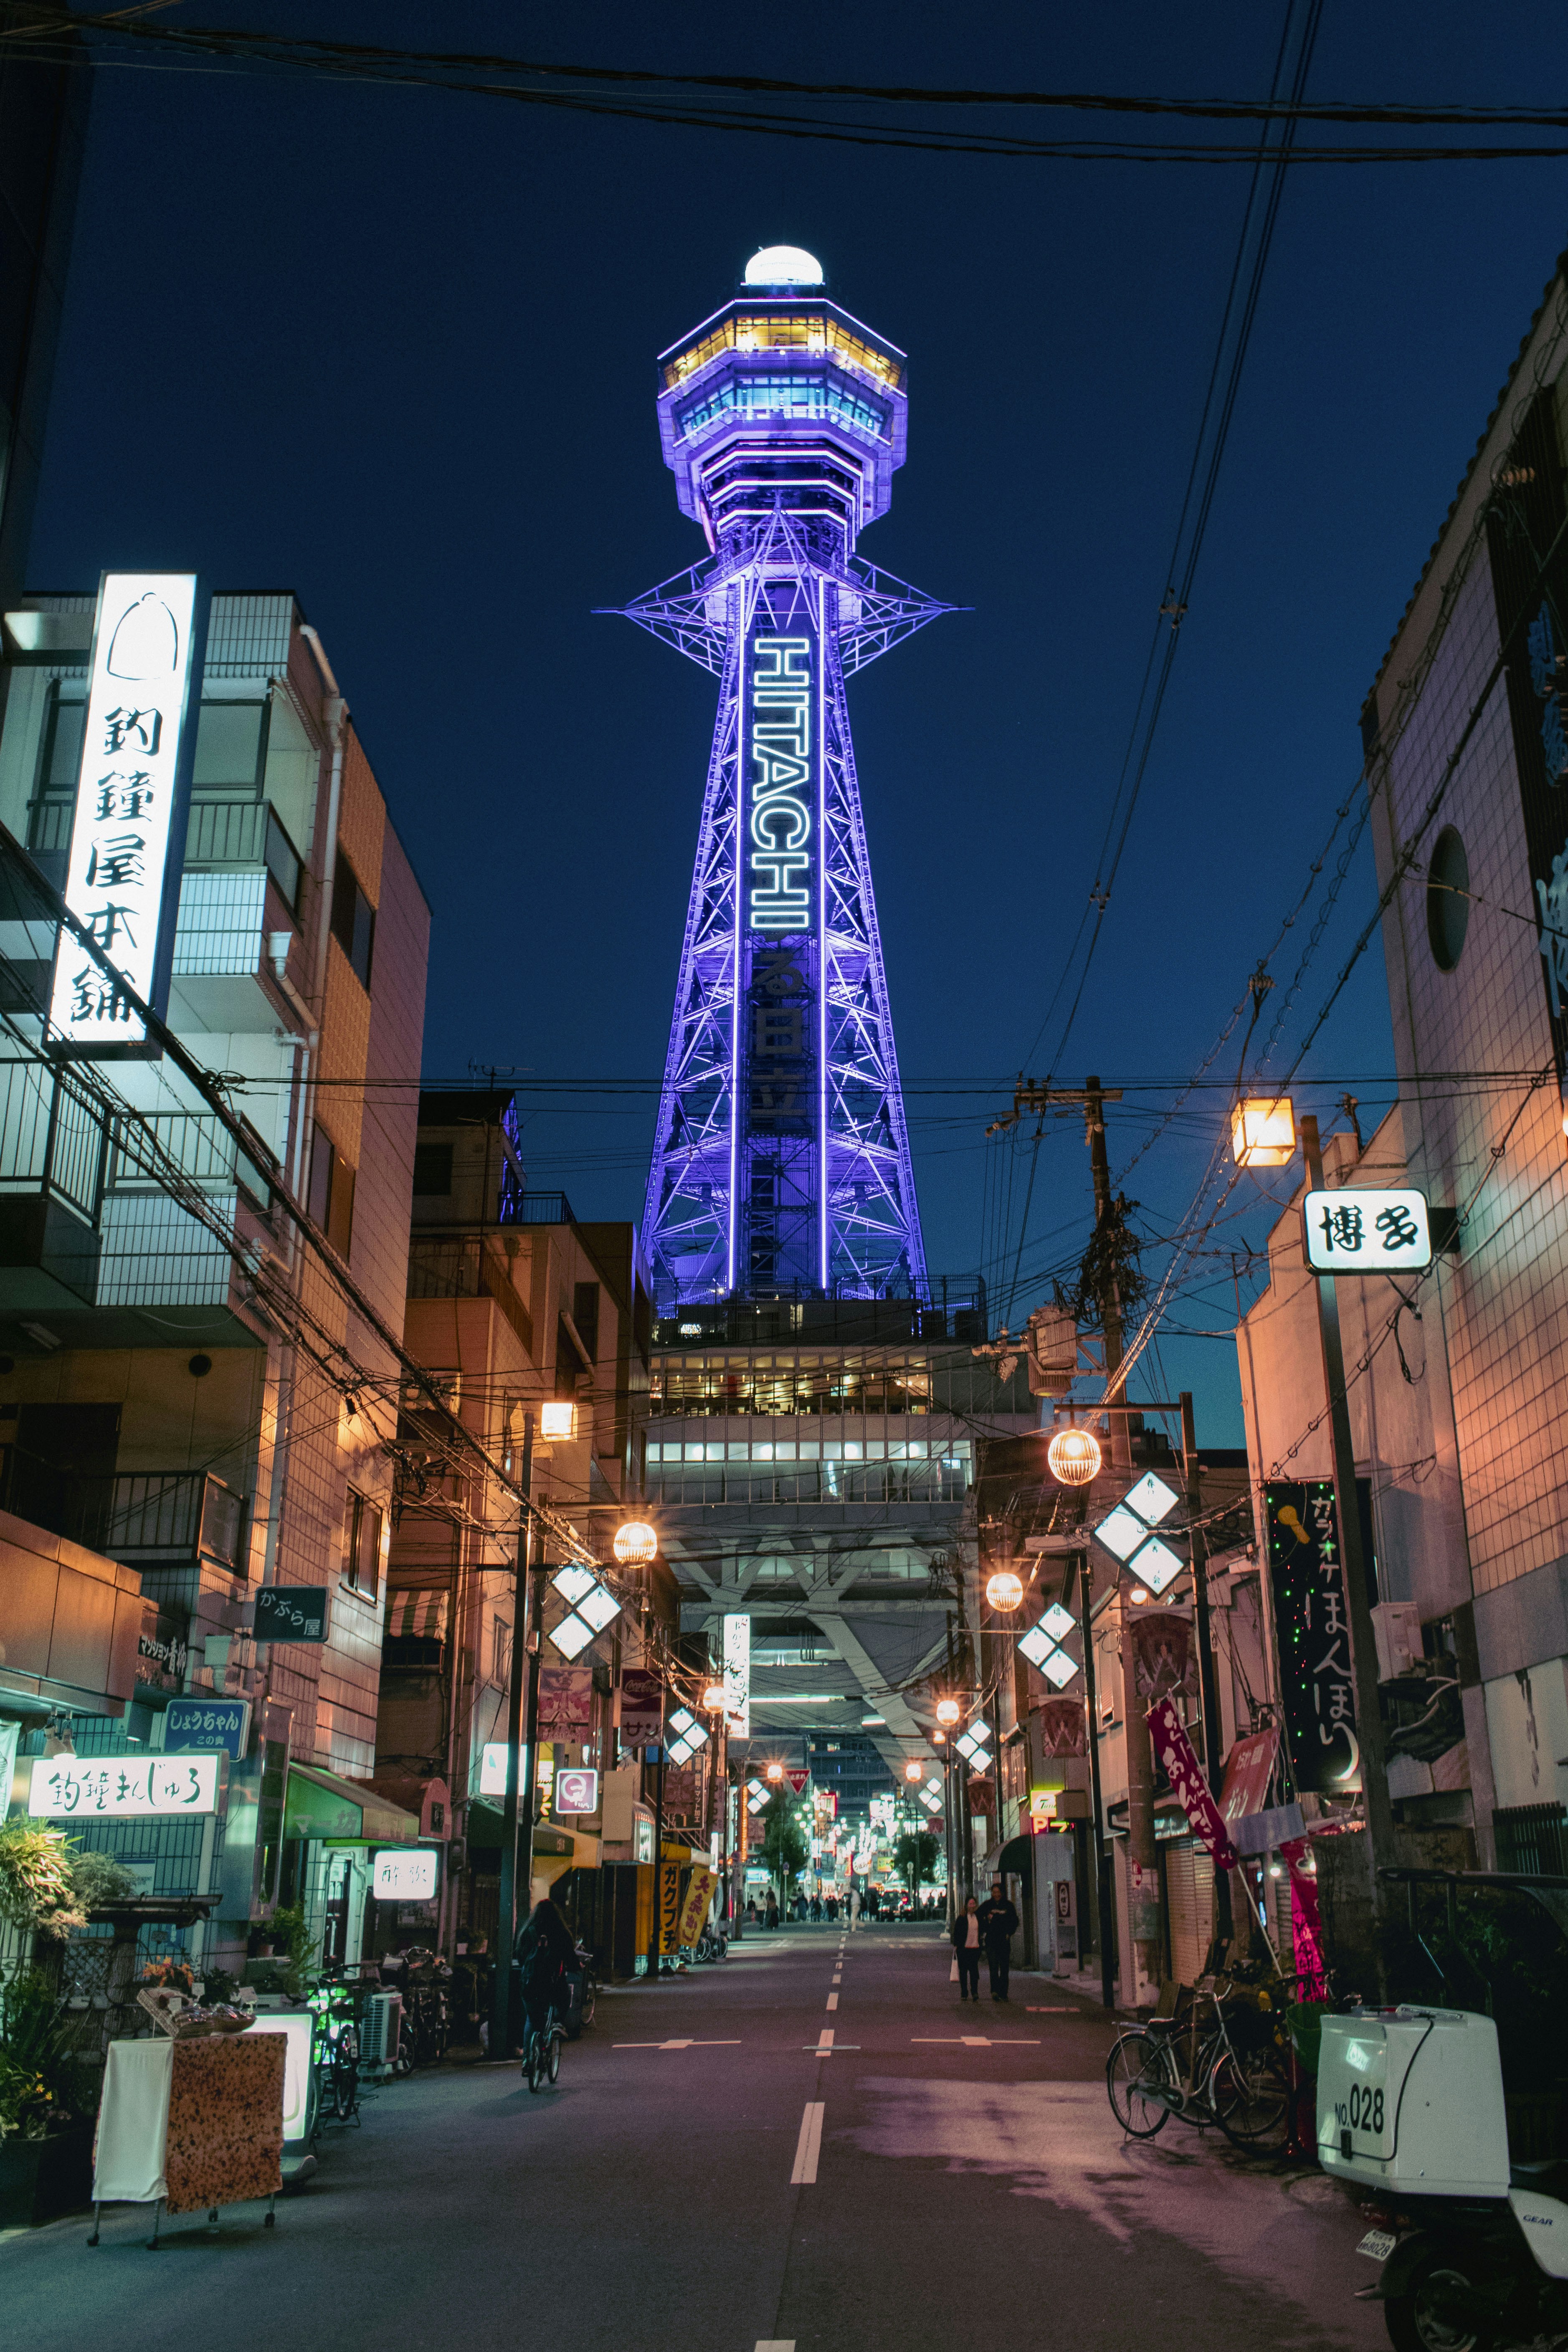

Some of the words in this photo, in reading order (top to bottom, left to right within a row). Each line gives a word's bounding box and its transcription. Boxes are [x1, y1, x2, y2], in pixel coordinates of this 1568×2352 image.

[752, 637, 810, 929] HITACHI
[70, 706, 164, 1023] 釣鐘屋本舗
[750, 930, 806, 1115] る日立
[1319, 1204, 1419, 1252] 博多
[1311, 1497, 1340, 1584] カラオケ
[259, 1591, 321, 1636] かぶら屋
[141, 1635, 187, 1677] マンション青柳
[170, 1710, 239, 1731] しょうちゃん
[48, 1761, 201, 1812] 釣鐘まんじゅう
[790, 1772, 806, 1781] 止まれ
[1033, 1817, 1047, 1834] P
[1523, 2214, 1553, 2227] GEAR
